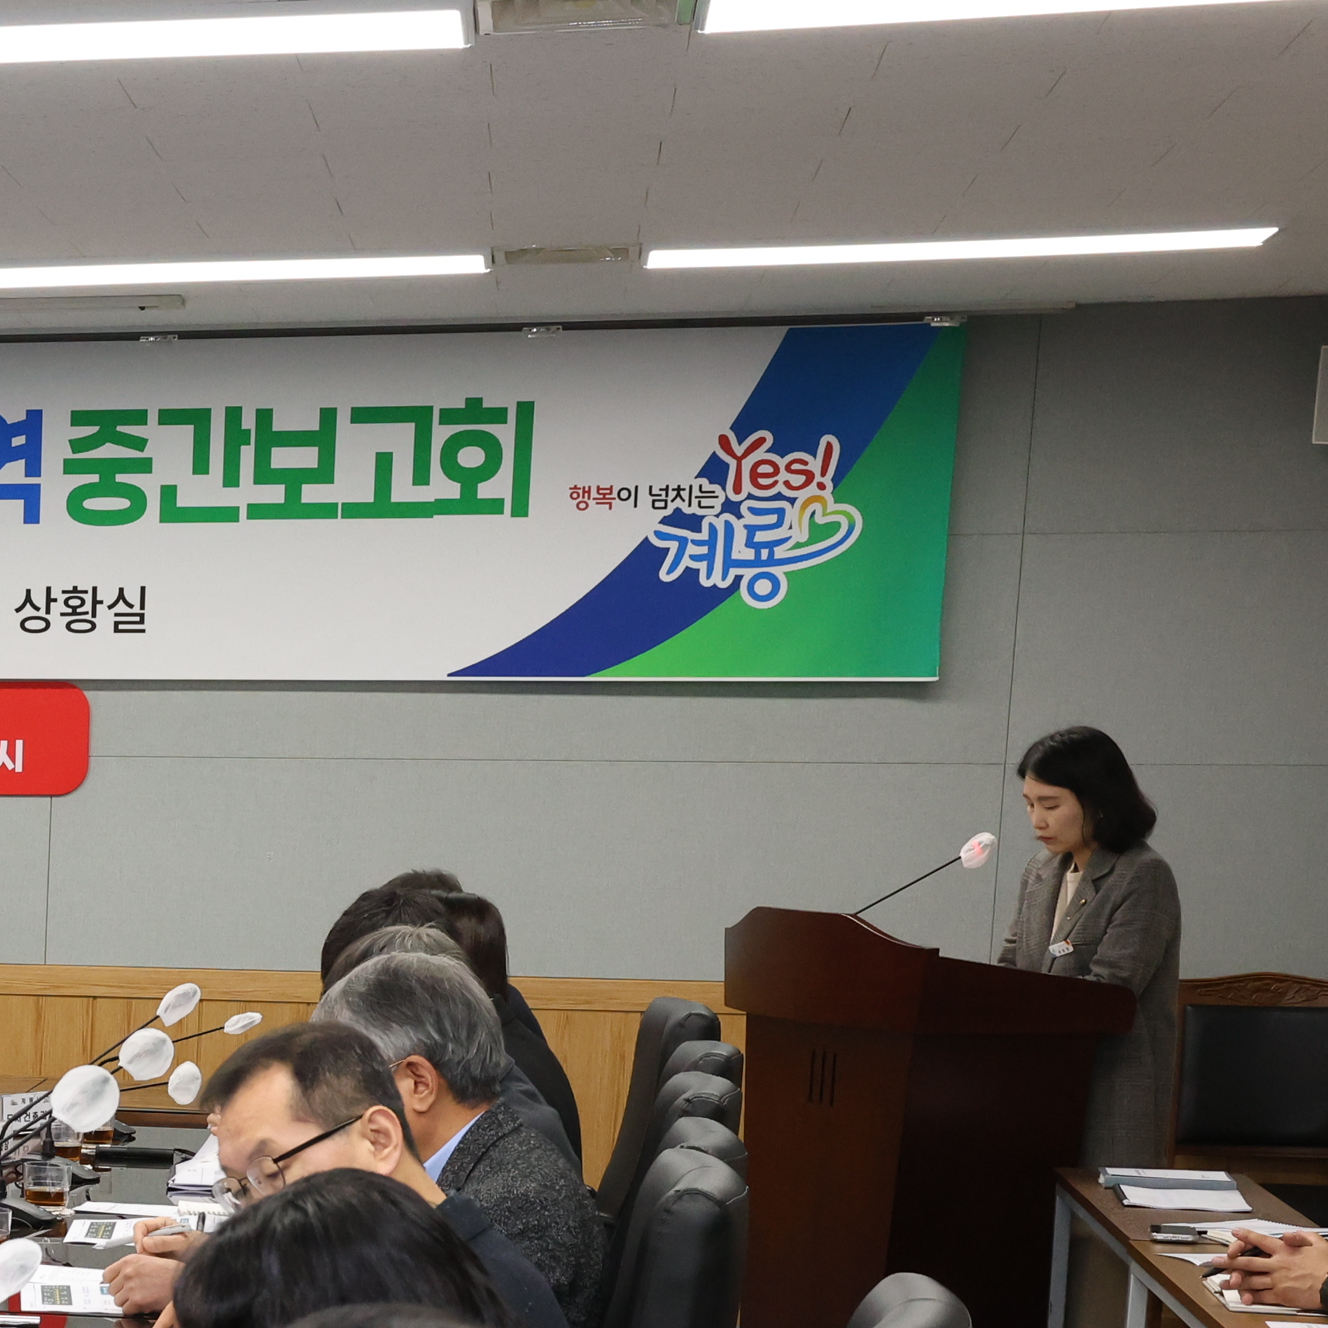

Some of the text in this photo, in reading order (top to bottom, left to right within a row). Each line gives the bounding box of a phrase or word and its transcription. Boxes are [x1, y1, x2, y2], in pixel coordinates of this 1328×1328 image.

[62, 397, 535, 528] 중간보고회
[717, 433, 834, 496] Yes!
[568, 483, 720, 511] 행복이 넘치는
[653, 500, 834, 602] 계룡
[13, 585, 149, 635] 상황실
